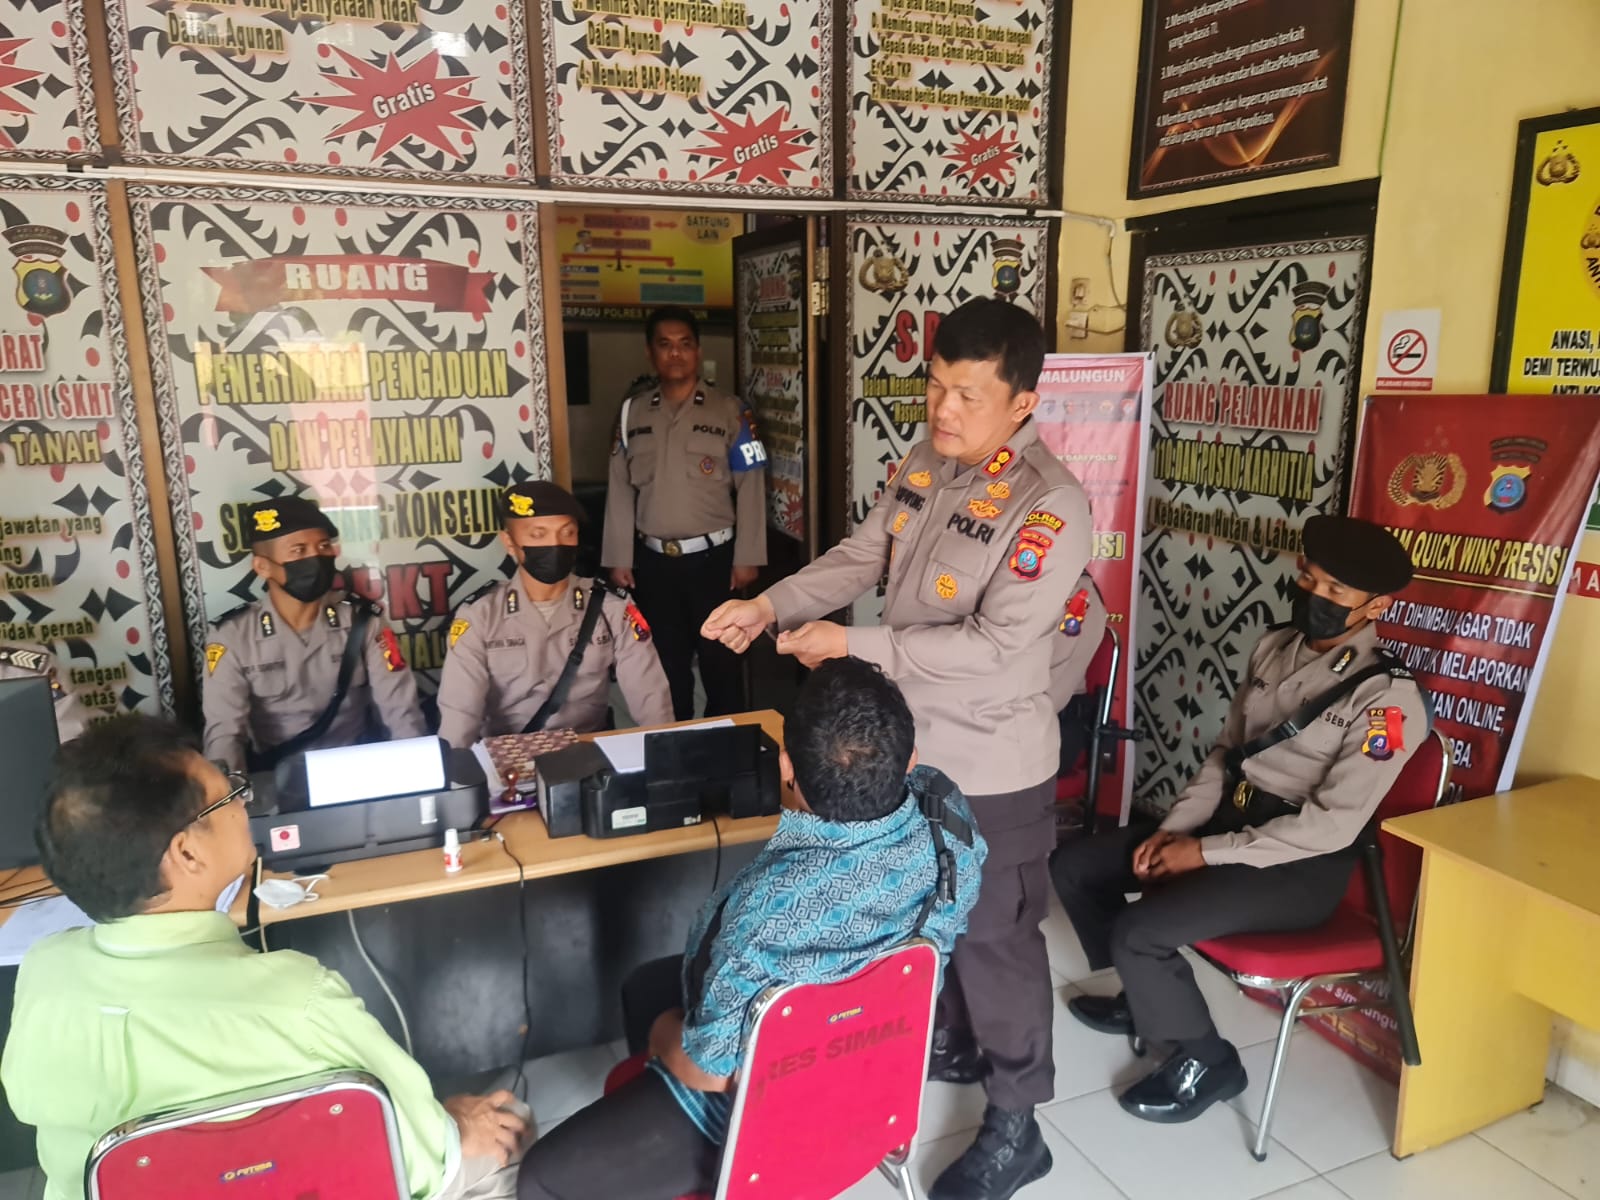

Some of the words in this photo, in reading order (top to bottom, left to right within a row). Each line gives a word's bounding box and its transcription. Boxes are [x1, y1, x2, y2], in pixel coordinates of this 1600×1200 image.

[721, 1, 748, 28] tidak
[168, 12, 220, 46] Dalam
[225, 17, 285, 55] Agunan
[587, 20, 621, 49] Dalam
[624, 25, 662, 54] Agunan
[592, 61, 639, 89] Membuat
[641, 65, 661, 91] BAP
[664, 67, 703, 97] Pelapor
[372, 81, 437, 120] Gratis
[733, 134, 779, 165] Gratis
[971, 146, 1001, 166] Gratis
[285, 263, 428, 291] RUANG
[1551, 330, 1594, 354] AWASI,
[368, 349, 509, 400] PENGADUAN
[1523, 357, 1552, 377] DEMI
[57, 382, 115, 420] SKHT
[1164, 381, 1216, 424] RUANG
[1220, 382, 1322, 433] PELAYANAN
[9, 430, 103, 465] TANAH
[269, 419, 326, 471] DAN
[327, 415, 463, 469] PELAYANAN
[693, 424, 726, 437] POLRI
[1154, 437, 1174, 480] 110
[1175, 438, 1199, 485] DAN
[1199, 440, 1242, 492] POSKO
[1242, 446, 1315, 502] KARHUTLA
[66, 516, 103, 535] yang
[946, 512, 996, 545] POLRI
[1153, 499, 1211, 535] Kebakaran
[1214, 508, 1250, 542] Hutan
[1252, 515, 1262, 545] &
[1411, 530, 1463, 572] QUICK
[1458, 535, 1501, 577] WINS
[1494, 538, 1569, 587] PRESISI
[6, 572, 50, 590] koran
[41, 617, 94, 642] pernah
[1403, 601, 1454, 636] DIHIMBAU
[1452, 610, 1491, 642] AGAR
[1493, 616, 1536, 649] TIDAK
[70, 662, 129, 686] tangani
[1406, 644, 1439, 674] UNTUK
[1439, 650, 1533, 694] MELAPORKAN
[80, 688, 117, 707] atas
[1455, 697, 1506, 736] ONLINE,
